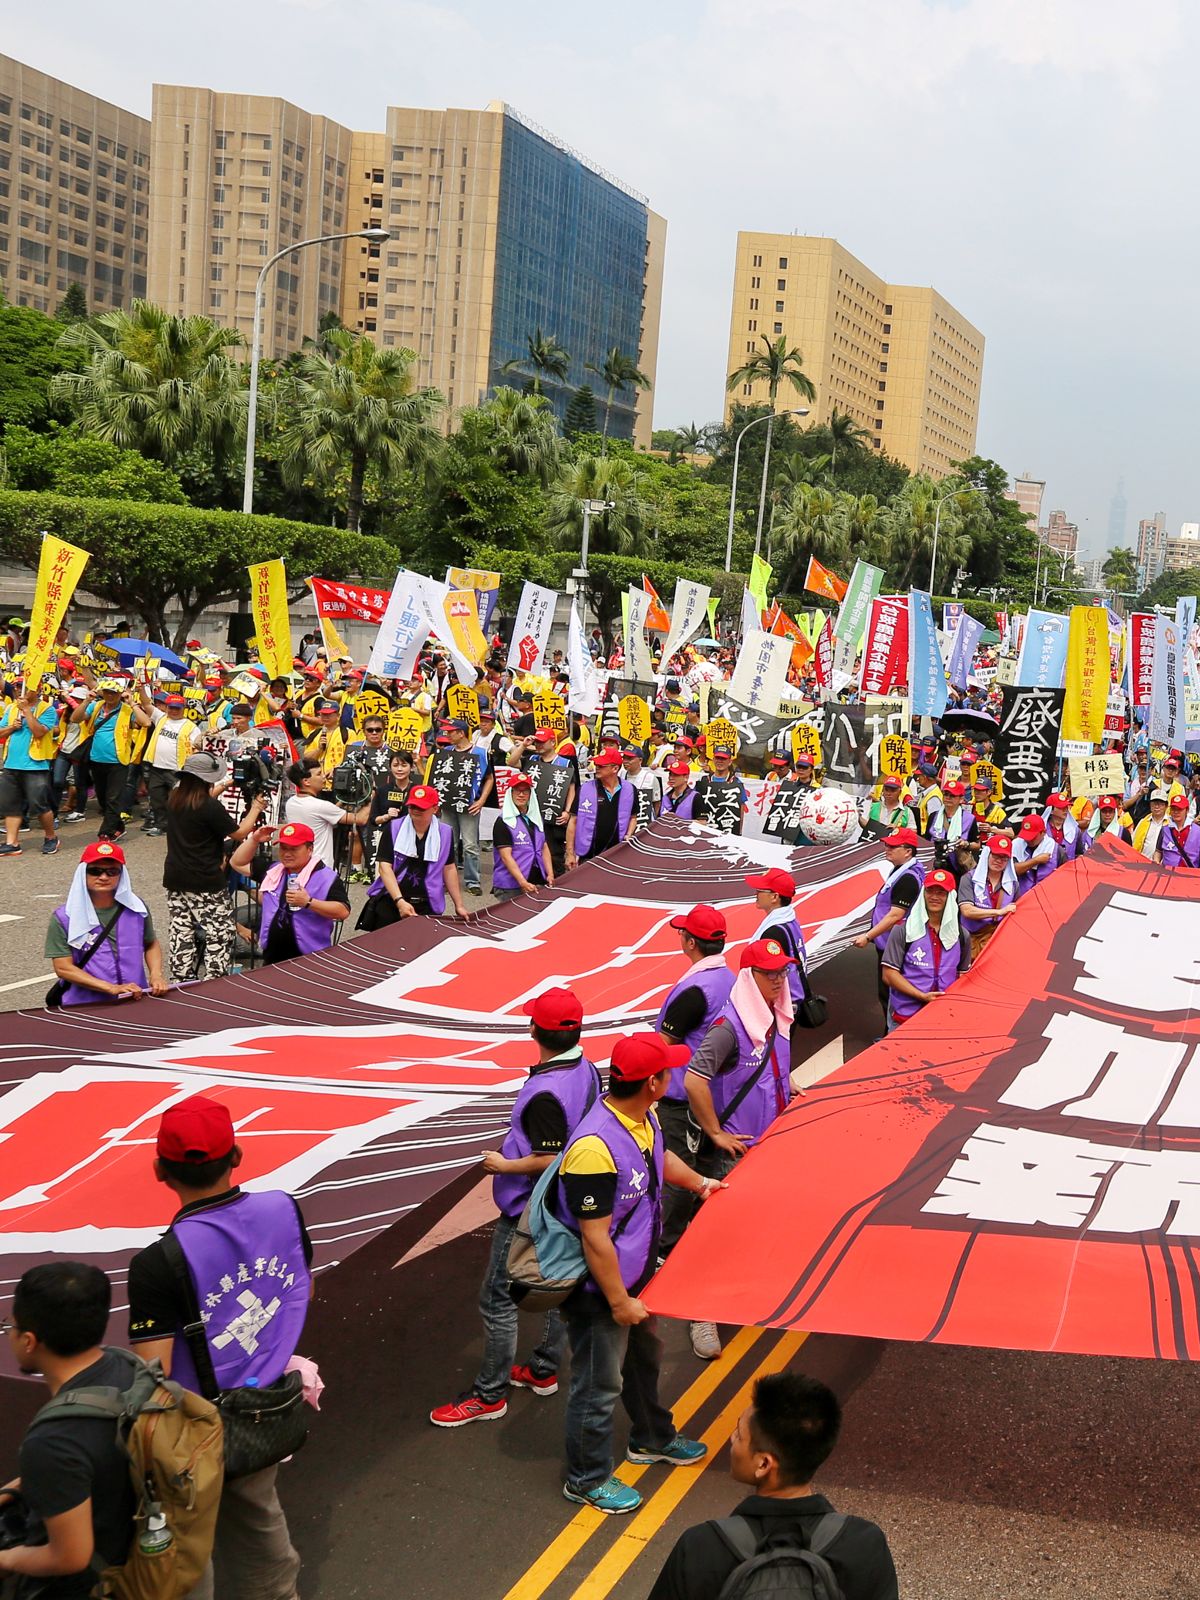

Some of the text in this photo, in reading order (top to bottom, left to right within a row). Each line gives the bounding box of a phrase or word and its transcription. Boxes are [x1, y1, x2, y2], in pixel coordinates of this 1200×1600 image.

[453, 687, 478, 728] 停飛
[535, 695, 550, 730] 二小過
[550, 696, 566, 730] 一大過
